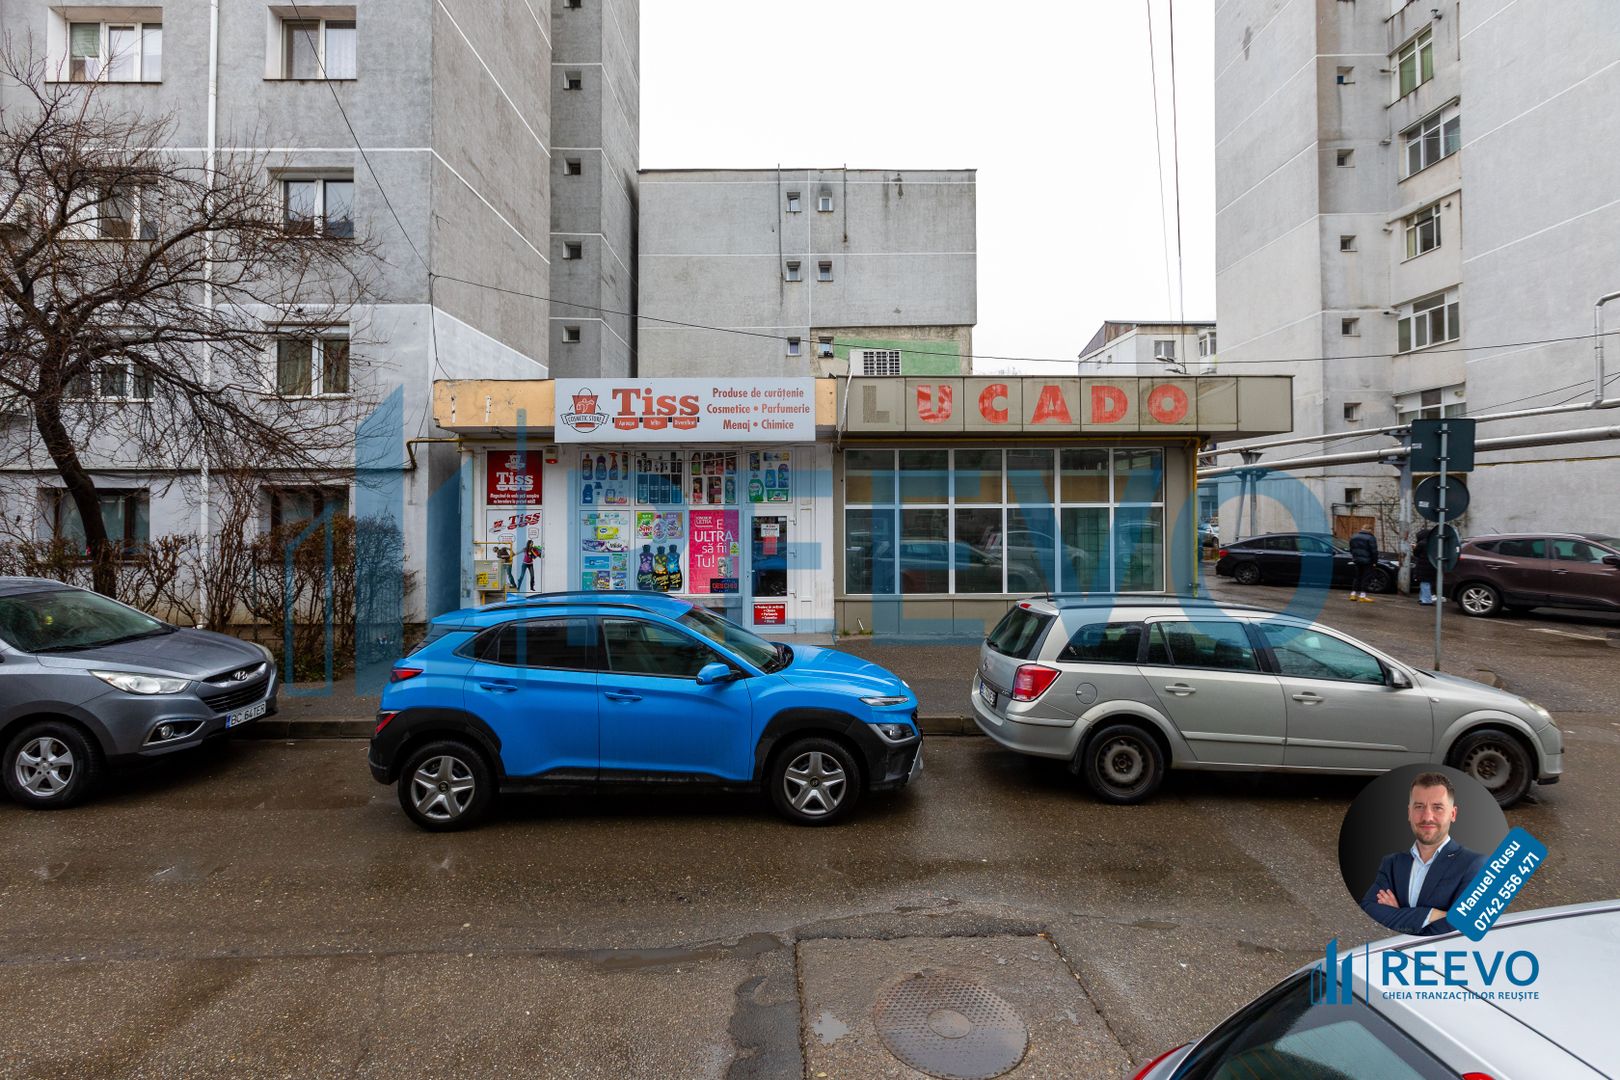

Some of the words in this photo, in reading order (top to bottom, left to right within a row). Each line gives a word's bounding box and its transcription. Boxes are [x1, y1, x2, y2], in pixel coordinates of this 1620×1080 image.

[712, 387, 748, 398] Produse
[750, 387, 761, 398] de
[764, 387, 804, 401] curățenie
[612, 387, 700, 416] Tiss
[706, 403, 751, 414] Cosmetice
[761, 403, 810, 414] Parfumerie
[723, 419, 750, 432] Menaj
[761, 419, 794, 430] Chimice
[496, 472, 534, 485] Tiss
[508, 512, 541, 525] Tiss
[716, 519, 724, 530] E
[694, 530, 734, 542] ULTRA
[702, 543, 714, 554] să
[716, 542, 727, 554] fii
[694, 554, 715, 568] Tu!
[231, 712, 242, 725] BC
